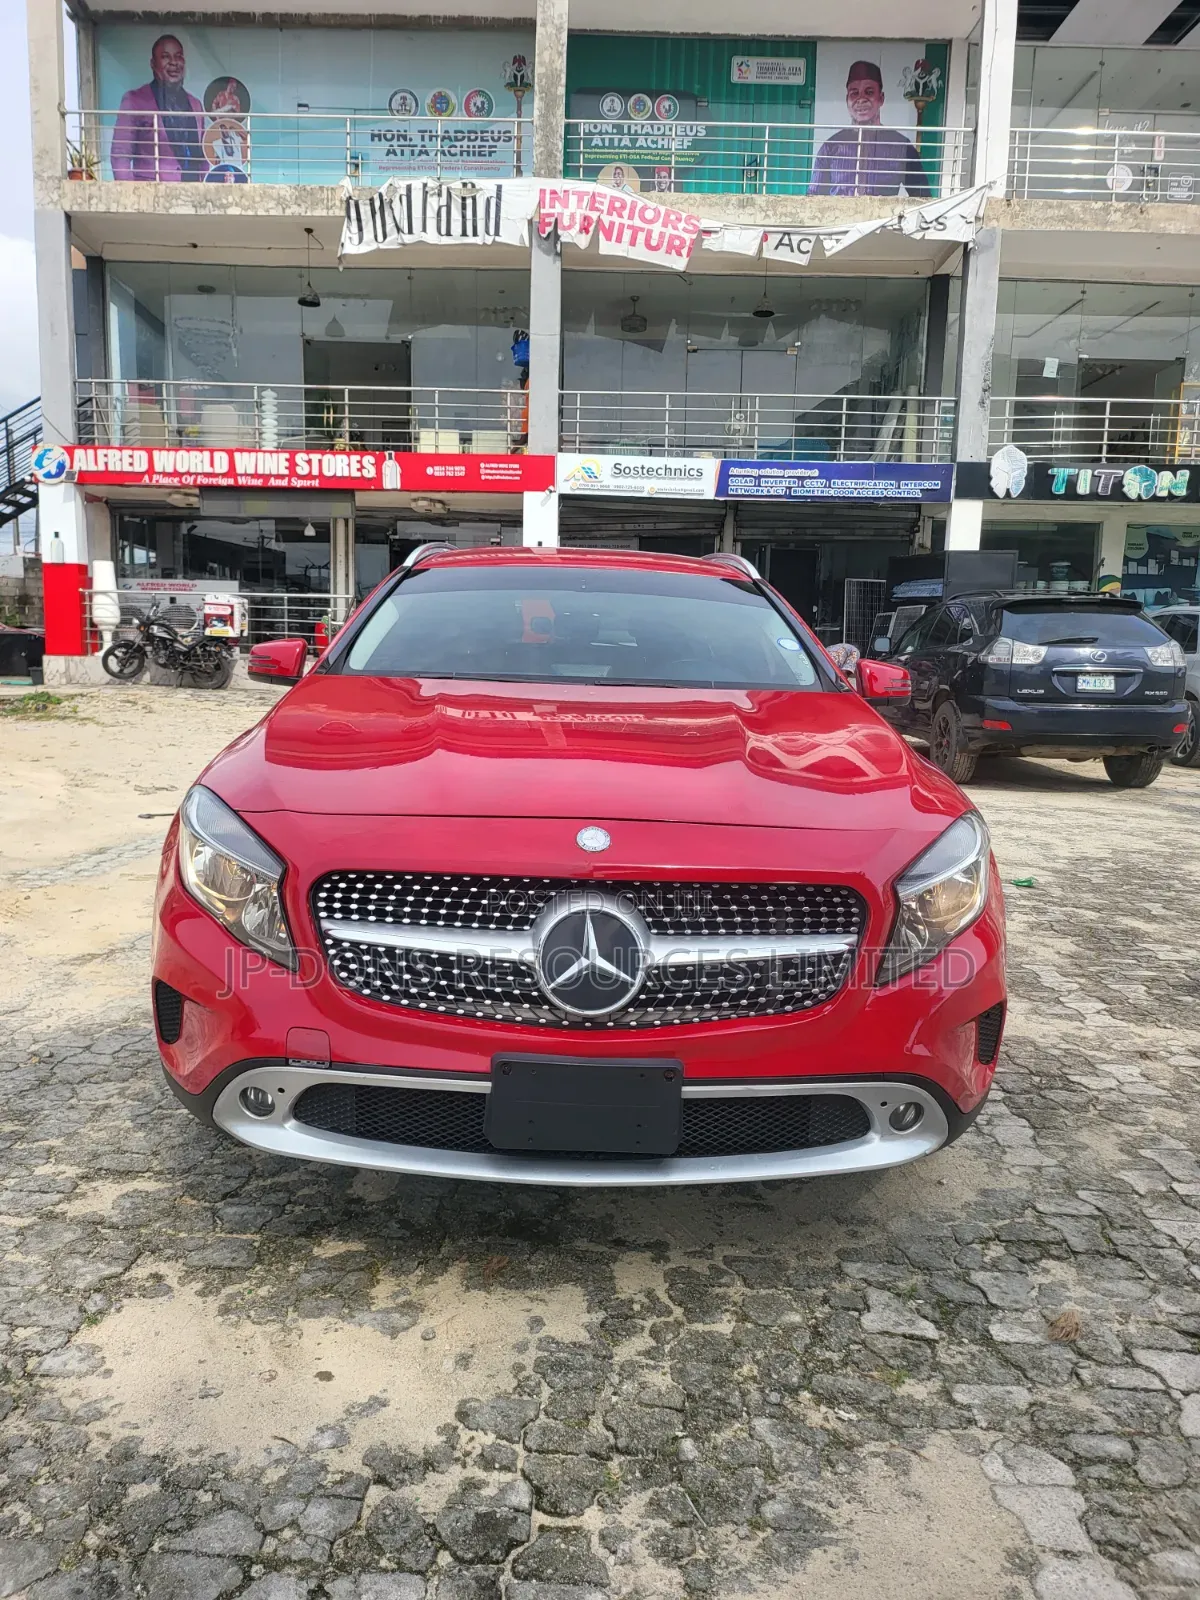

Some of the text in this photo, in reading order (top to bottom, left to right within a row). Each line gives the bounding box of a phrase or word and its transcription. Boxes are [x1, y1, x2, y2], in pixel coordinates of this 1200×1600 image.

[370, 129, 513, 143] HON. THADDEUS
[578, 123, 707, 136] HON. THADDEUS
[590, 135, 693, 149] ATTA ACHIEF
[385, 143, 498, 157] ATTA ACHIEF
[539, 188, 701, 235] INTERIORS
[73, 448, 377, 478] ALFRED WORLD WINE STORES
[613, 463, 703, 478] Sostechnics
[141, 475, 150, 484] A
[152, 475, 181, 485] Place
[182, 475, 196, 485] Of
[197, 475, 234, 487] Foreign
[237, 477, 263, 486] Wine
[268, 477, 288, 487] And
[832, 480, 895, 488] ELECTRIFICATION
